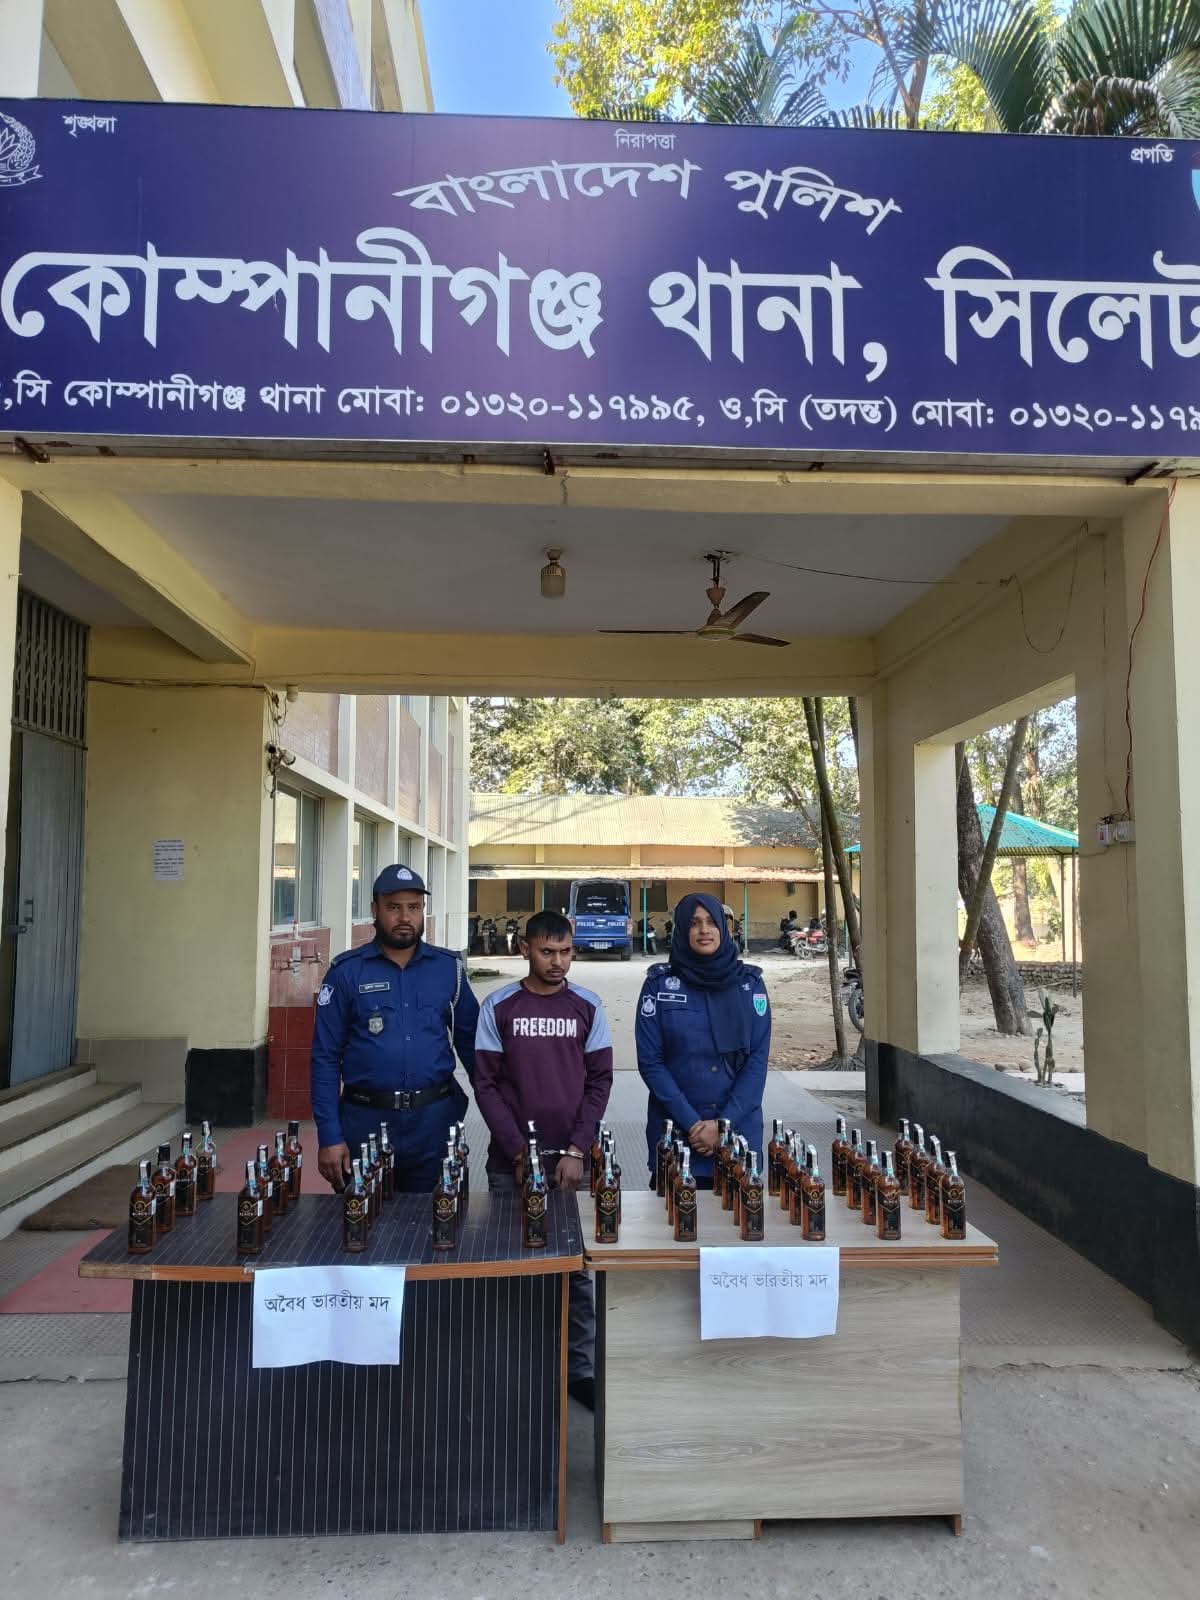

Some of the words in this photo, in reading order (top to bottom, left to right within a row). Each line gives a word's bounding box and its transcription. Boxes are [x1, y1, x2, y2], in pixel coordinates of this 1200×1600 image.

[613, 127, 677, 151] নিরাপত্তা
[1130, 143, 1176, 164] প্রগতি
[392, 159, 702, 217] বাংলাদেশ
[723, 165, 903, 236] পুলিশ
[1, 226, 606, 359] কোম্পানীগঞ্জ
[648, 256, 888, 382] থানা,
[0, 369, 53, 411] ,সি
[64, 373, 247, 413] কোম্পানীগঞ্জ
[259, 382, 327, 414] থানা
[440, 390, 706, 428] ০১৩২০-১১৭৯৯৫,
[799, 393, 898, 433] (তদন্ত)
[512, 1016, 578, 1038] FREEDOM
[710, 1271, 748, 1290] অবৈধ
[752, 1268, 804, 1289] ভারতীয়
[807, 1274, 829, 1289] মদ
[263, 1294, 308, 1314] অবৈধ
[311, 1289, 365, 1311] ভারতীয়
[367, 1295, 392, 1313] মদ
